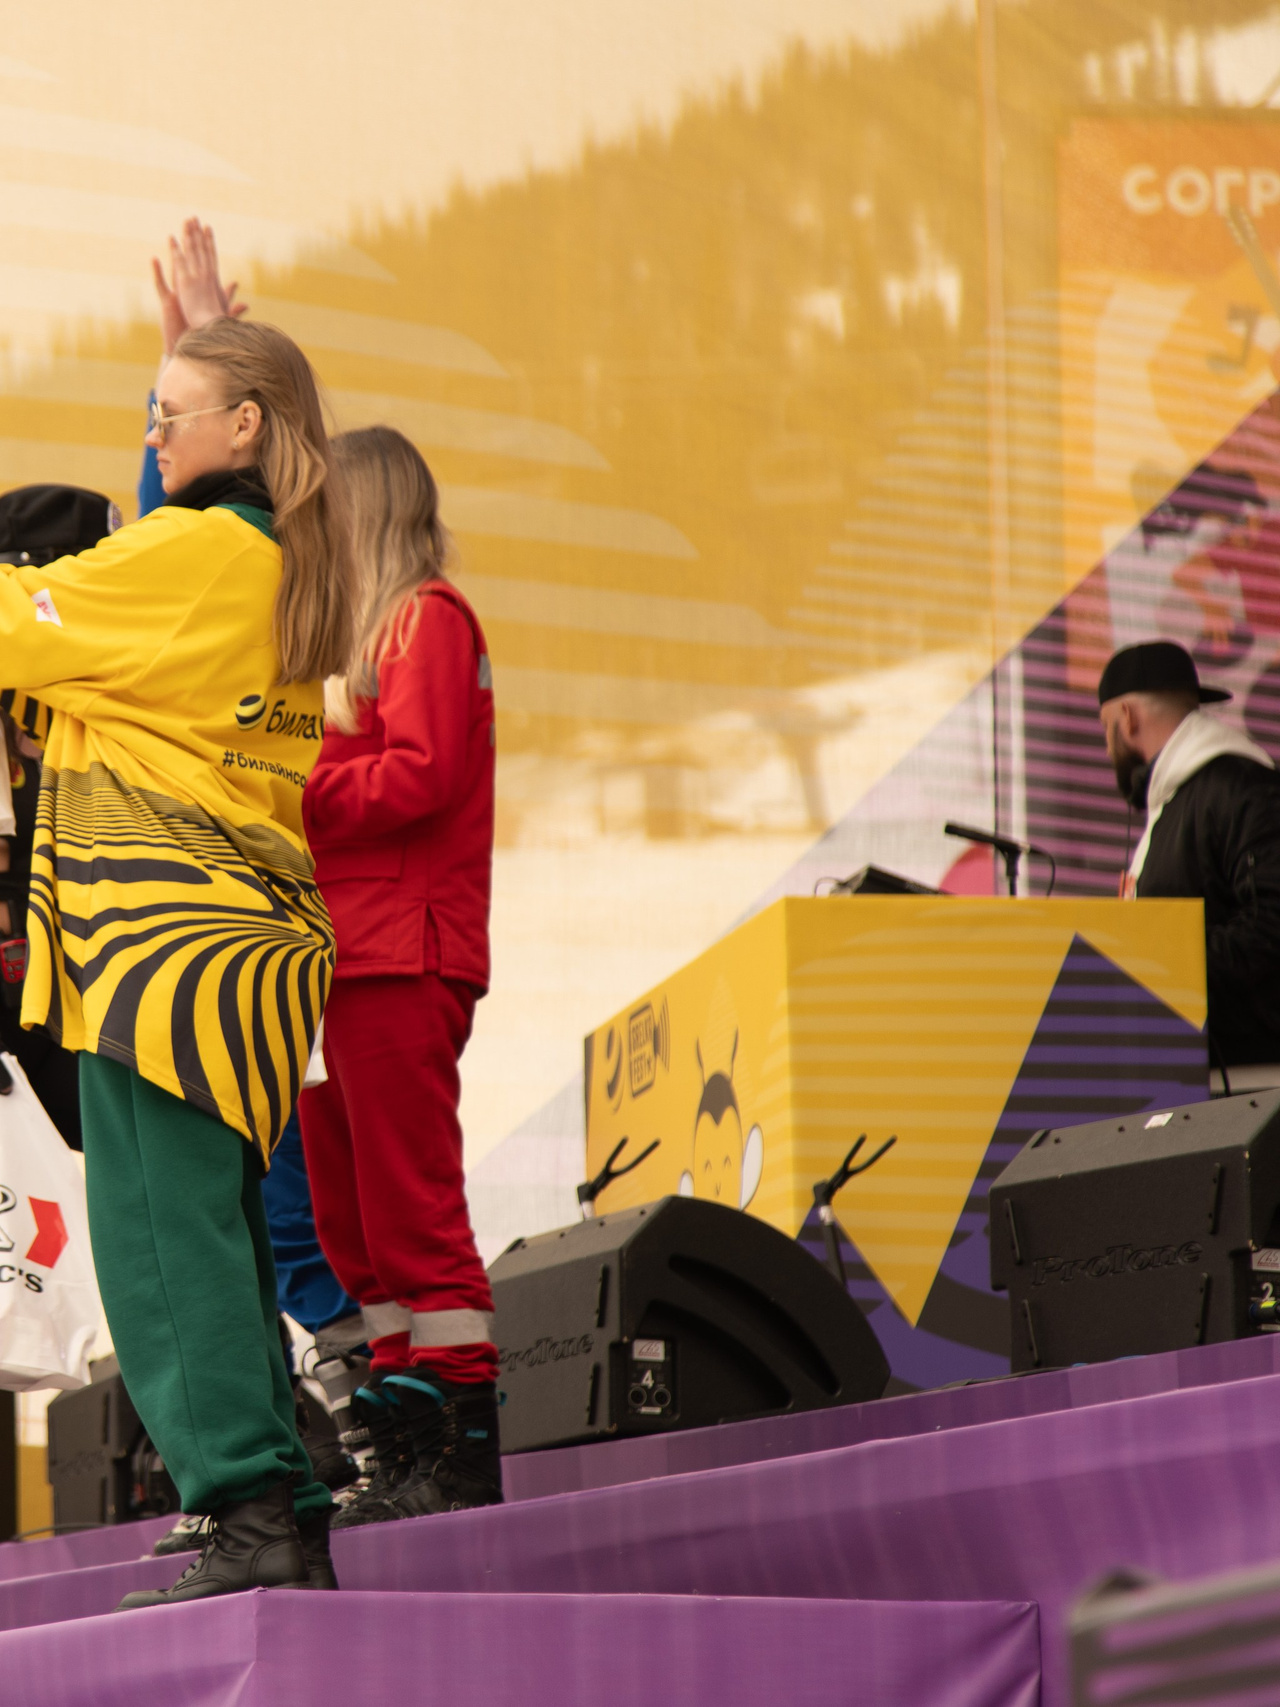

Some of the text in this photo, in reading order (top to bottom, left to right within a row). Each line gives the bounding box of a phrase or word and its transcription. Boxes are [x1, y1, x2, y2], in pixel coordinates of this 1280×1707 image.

[1122, 163, 1280, 217] СОГР
[1032, 1241, 1203, 1286] ProTone
[641, 1370, 655, 1389] 4
